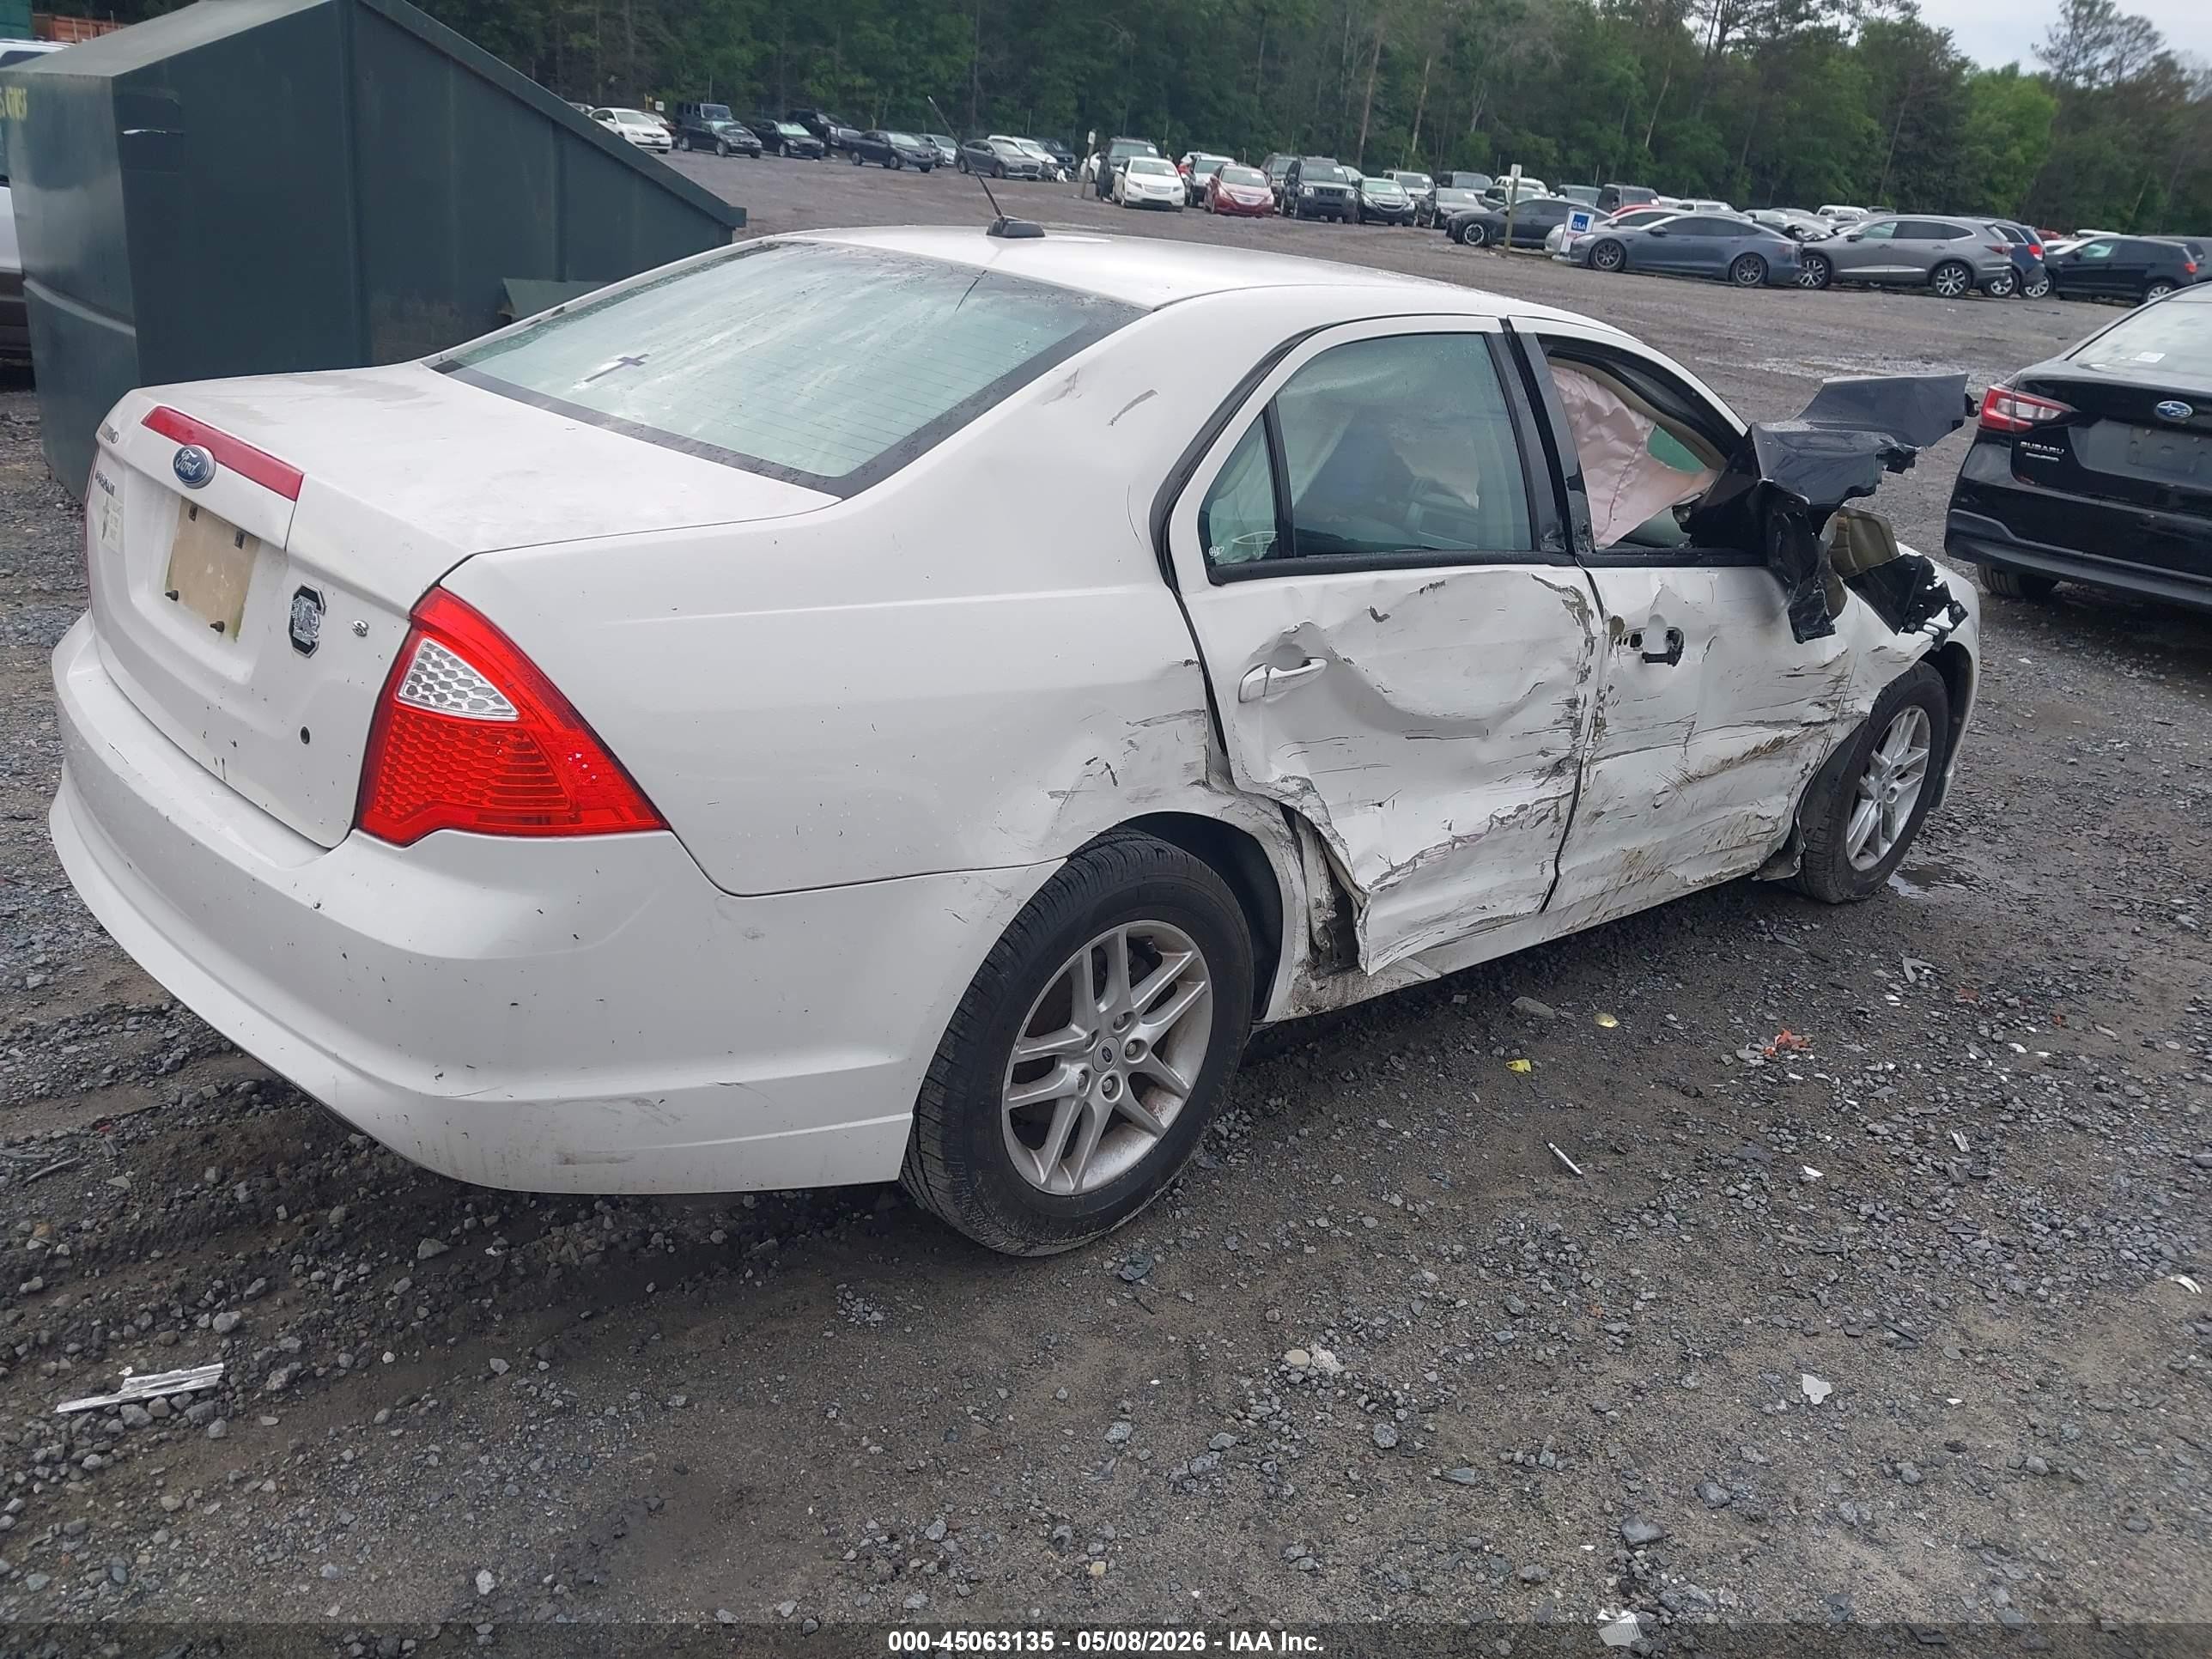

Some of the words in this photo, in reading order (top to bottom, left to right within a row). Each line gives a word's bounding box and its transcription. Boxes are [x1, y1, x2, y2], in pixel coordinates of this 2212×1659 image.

[2020, 441, 2065, 454] SUBARU
[176, 449, 200, 476] Ford
[351, 618, 369, 637] S
